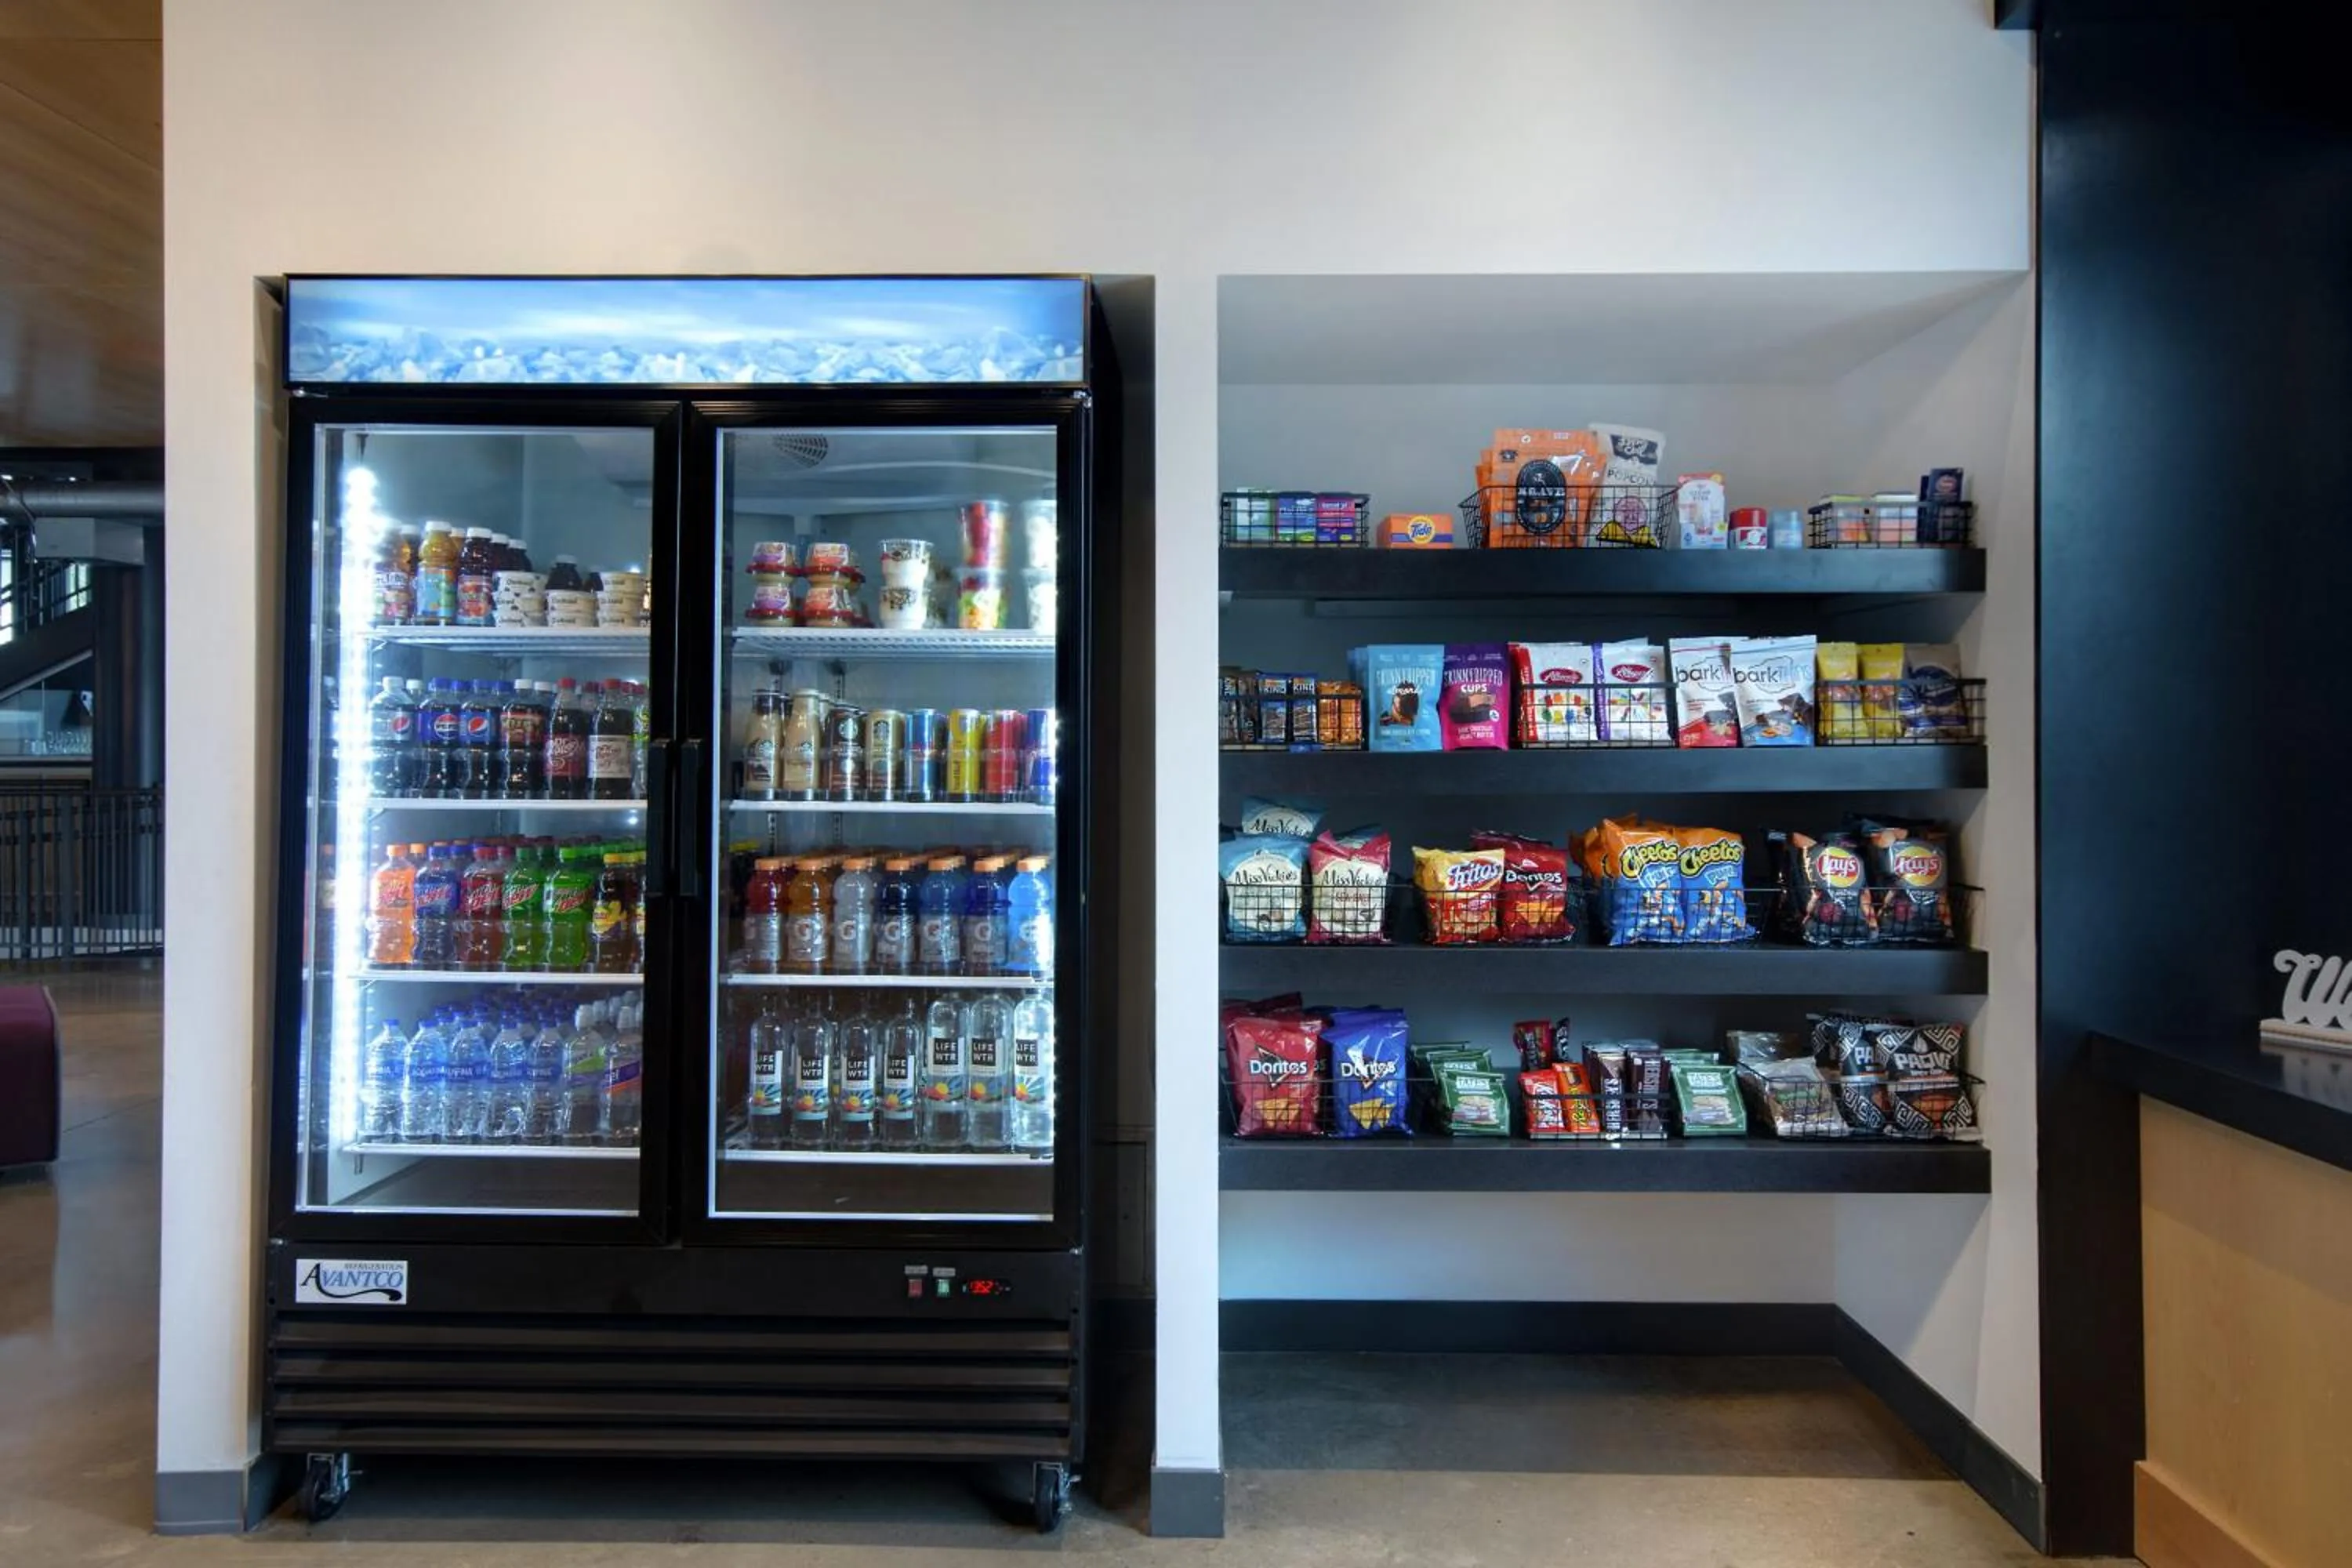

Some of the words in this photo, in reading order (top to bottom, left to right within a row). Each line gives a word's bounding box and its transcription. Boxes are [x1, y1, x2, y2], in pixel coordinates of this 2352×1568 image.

[1460, 683, 1488, 693] CUPS
[1621, 842, 1679, 879] Cheetos
[1679, 839, 1742, 878] Cheetos
[1446, 863, 1501, 891] Fritos
[935, 1042, 957, 1051] LIFE
[973, 1043, 994, 1051] LIFE
[802, 1059, 822, 1068] LIFE
[848, 1060, 868, 1069] LIFE
[1249, 1059, 1308, 1075] Doritos
[1341, 1061, 1396, 1076] Doritos
[300, 1262, 404, 1294] AVANTCO
